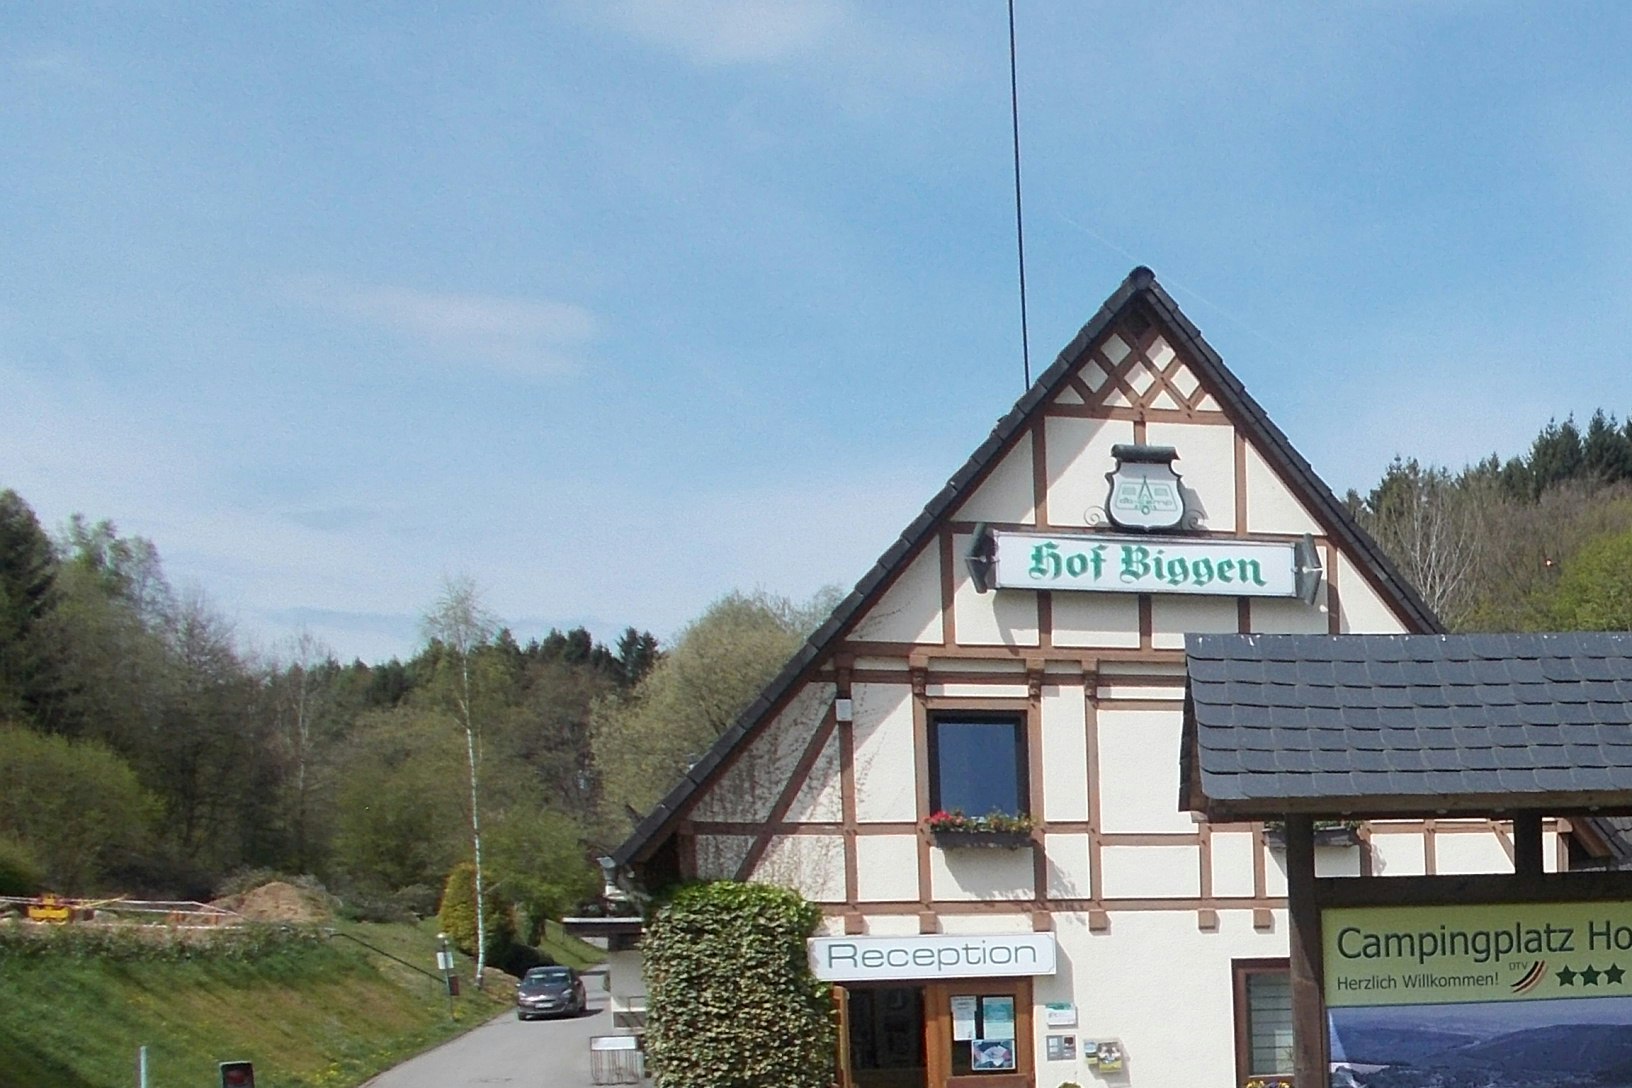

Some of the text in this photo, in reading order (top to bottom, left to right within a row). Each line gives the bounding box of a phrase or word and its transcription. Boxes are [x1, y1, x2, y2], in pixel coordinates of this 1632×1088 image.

[1028, 541, 1267, 587] Hof Biggen
[827, 940, 1037, 971] Reception
[1337, 921, 1575, 965] Campingplatz
[1337, 971, 1499, 991] Herzlich Willkommen!
[1508, 961, 1529, 971] DTV
